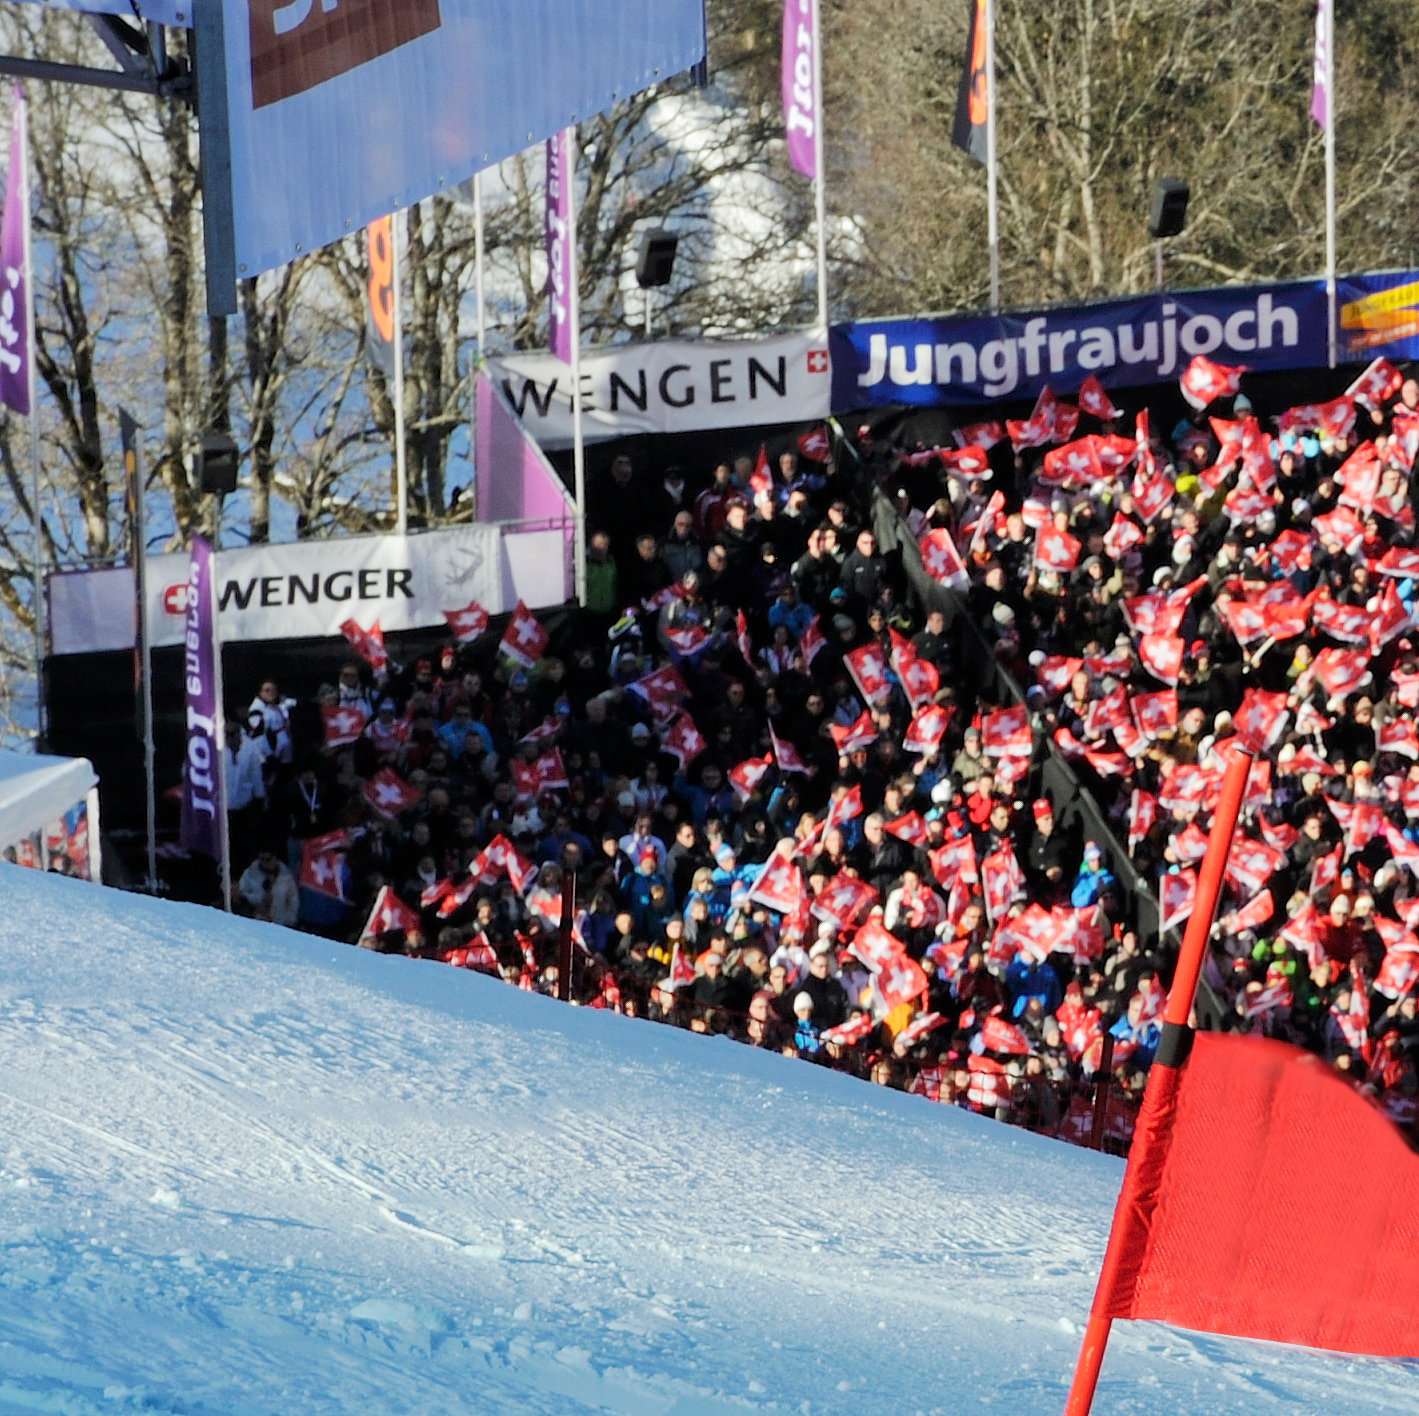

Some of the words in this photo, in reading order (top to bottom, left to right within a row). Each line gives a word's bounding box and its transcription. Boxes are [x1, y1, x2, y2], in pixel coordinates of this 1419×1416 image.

[857, 293, 1300, 397] Jungfraujoch
[501, 355, 788, 419] WENGEN
[218, 567, 415, 613] WENGER
